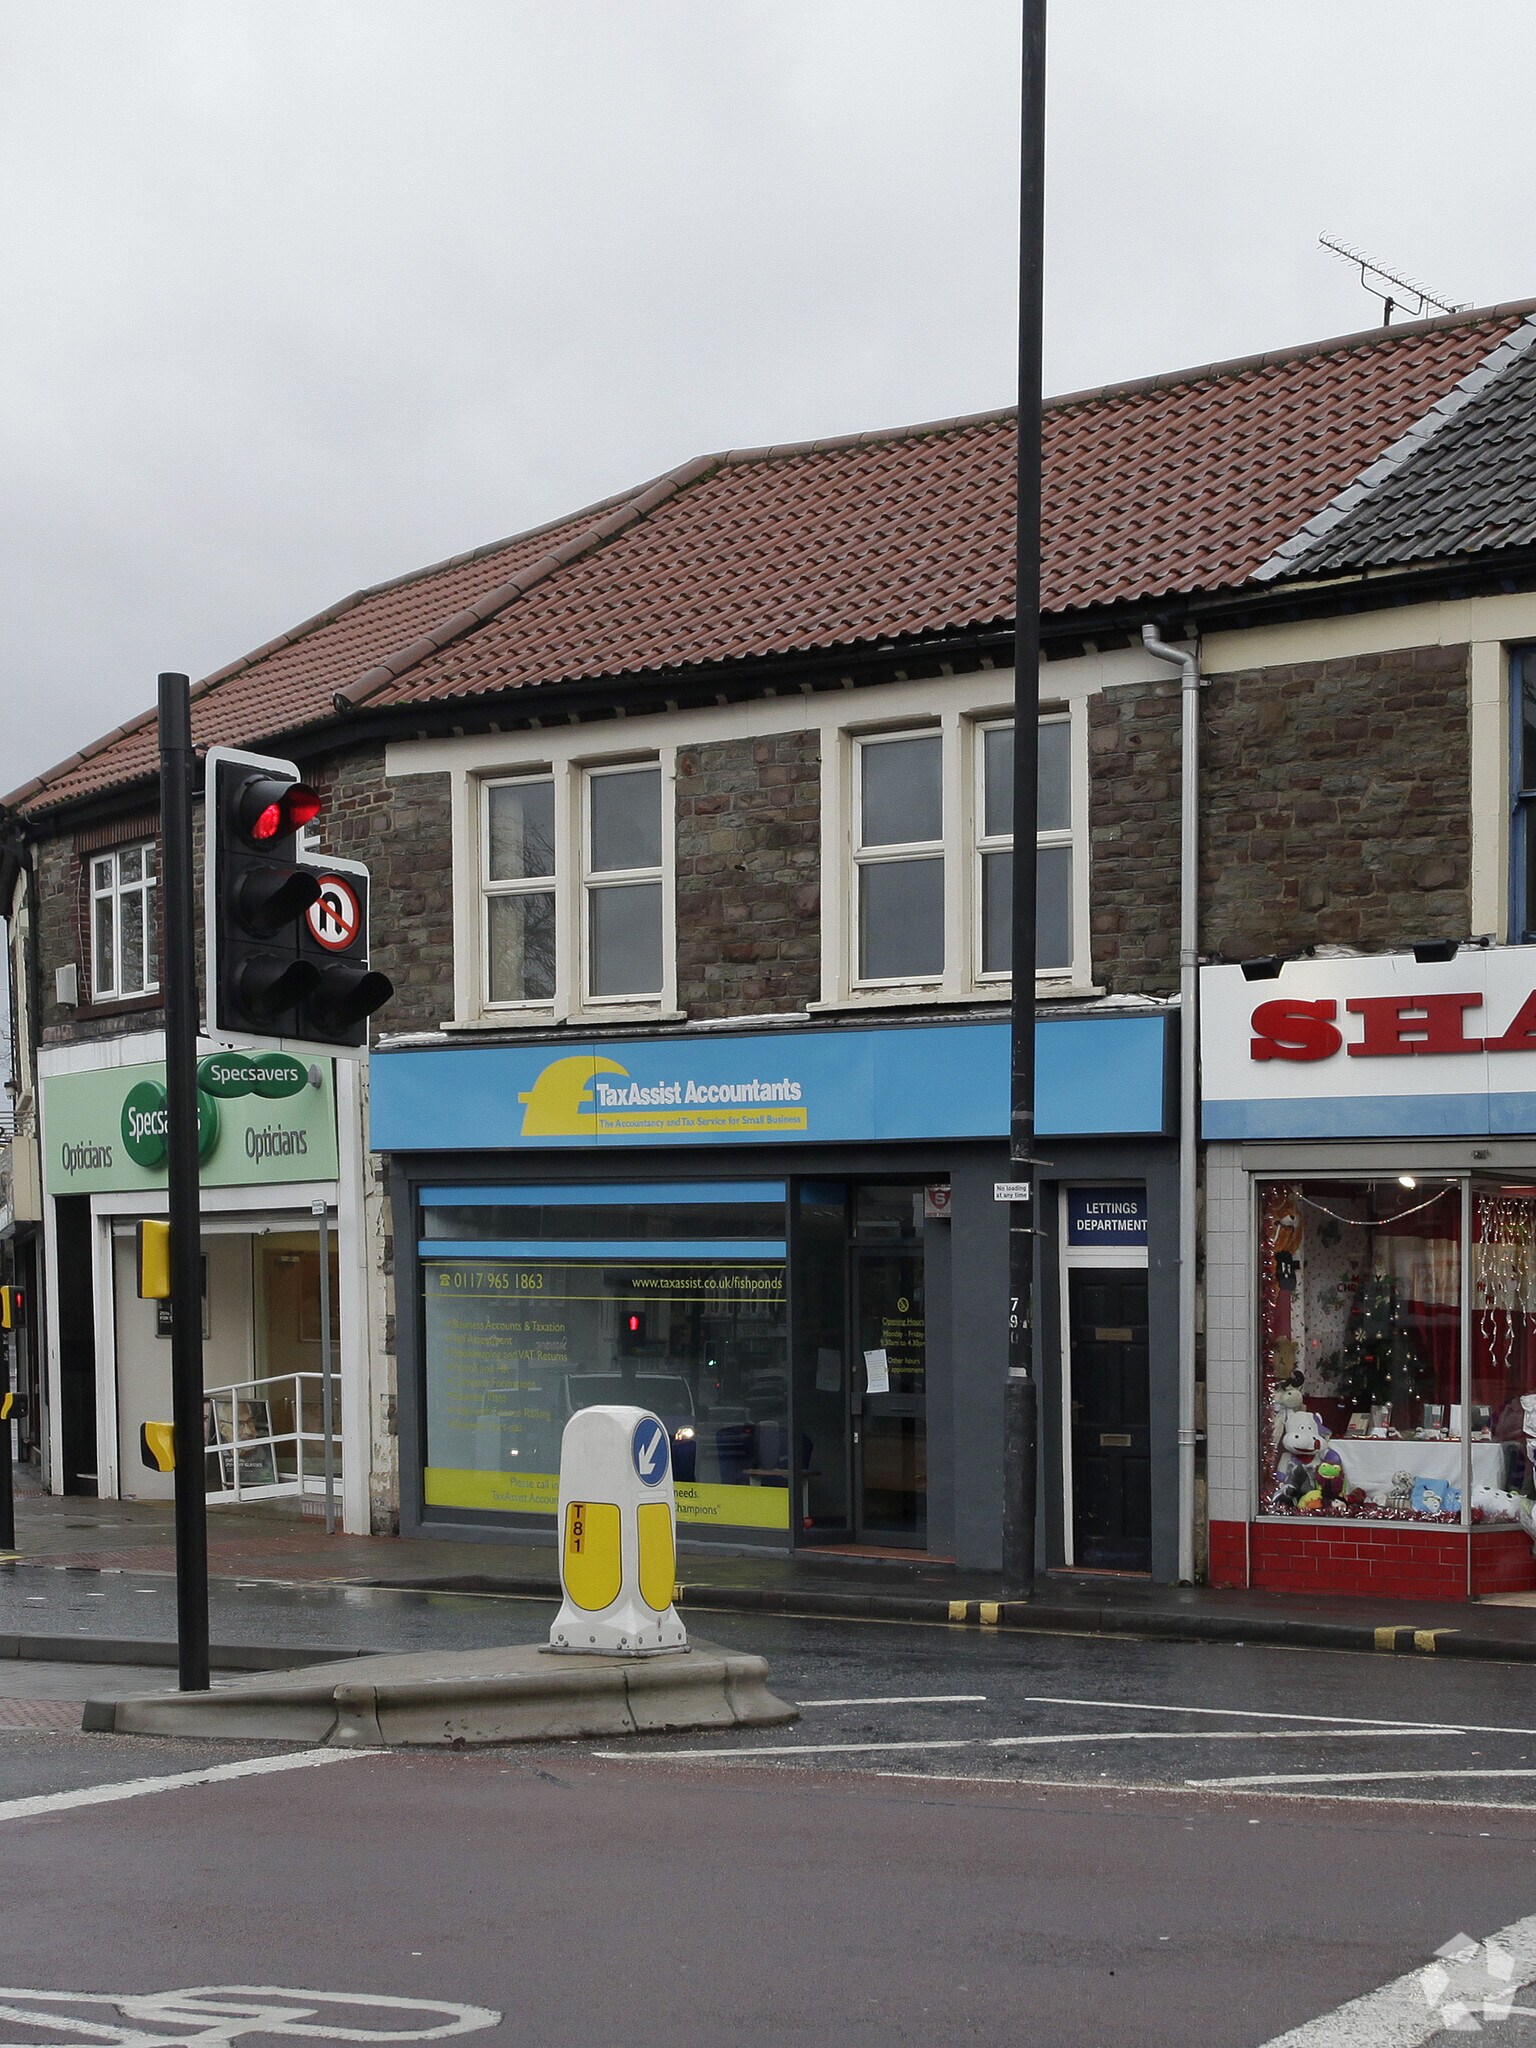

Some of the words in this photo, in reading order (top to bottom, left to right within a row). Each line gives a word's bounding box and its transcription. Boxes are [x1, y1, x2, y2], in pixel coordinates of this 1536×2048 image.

[211, 1065, 299, 1085] Specsavers
[596, 1081, 682, 1106] TaxAssist
[684, 1078, 802, 1104] Accountants
[128, 1106, 200, 1143] Specs
[600, 1119, 613, 1128] The
[615, 1118, 665, 1129] Accountancy
[667, 1117, 680, 1126] and
[681, 1117, 695, 1126] Tax
[698, 1117, 726, 1126] Service
[729, 1115, 740, 1124] for
[742, 1115, 764, 1124] Small
[767, 1114, 801, 1124] Business
[246, 1124, 307, 1165] Opticians
[62, 1140, 112, 1176] Opticians
[1086, 1202, 1138, 1214] LETTINGS
[1077, 1219, 1148, 1231] DEPARTMENT
[454, 1273, 483, 1288] 0117
[487, 1273, 509, 1289] 965
[515, 1273, 543, 1289] 1863
[632, 1276, 782, 1292] www.taxassist.co.uk/fishponds
[485, 1320, 521, 1332] Accounts
[524, 1321, 530, 1331] &
[531, 1320, 566, 1332] Taxation
[517, 1350, 535, 1360] VAT
[537, 1351, 568, 1362] Returns
[530, 1493, 559, 1504] Accoun
